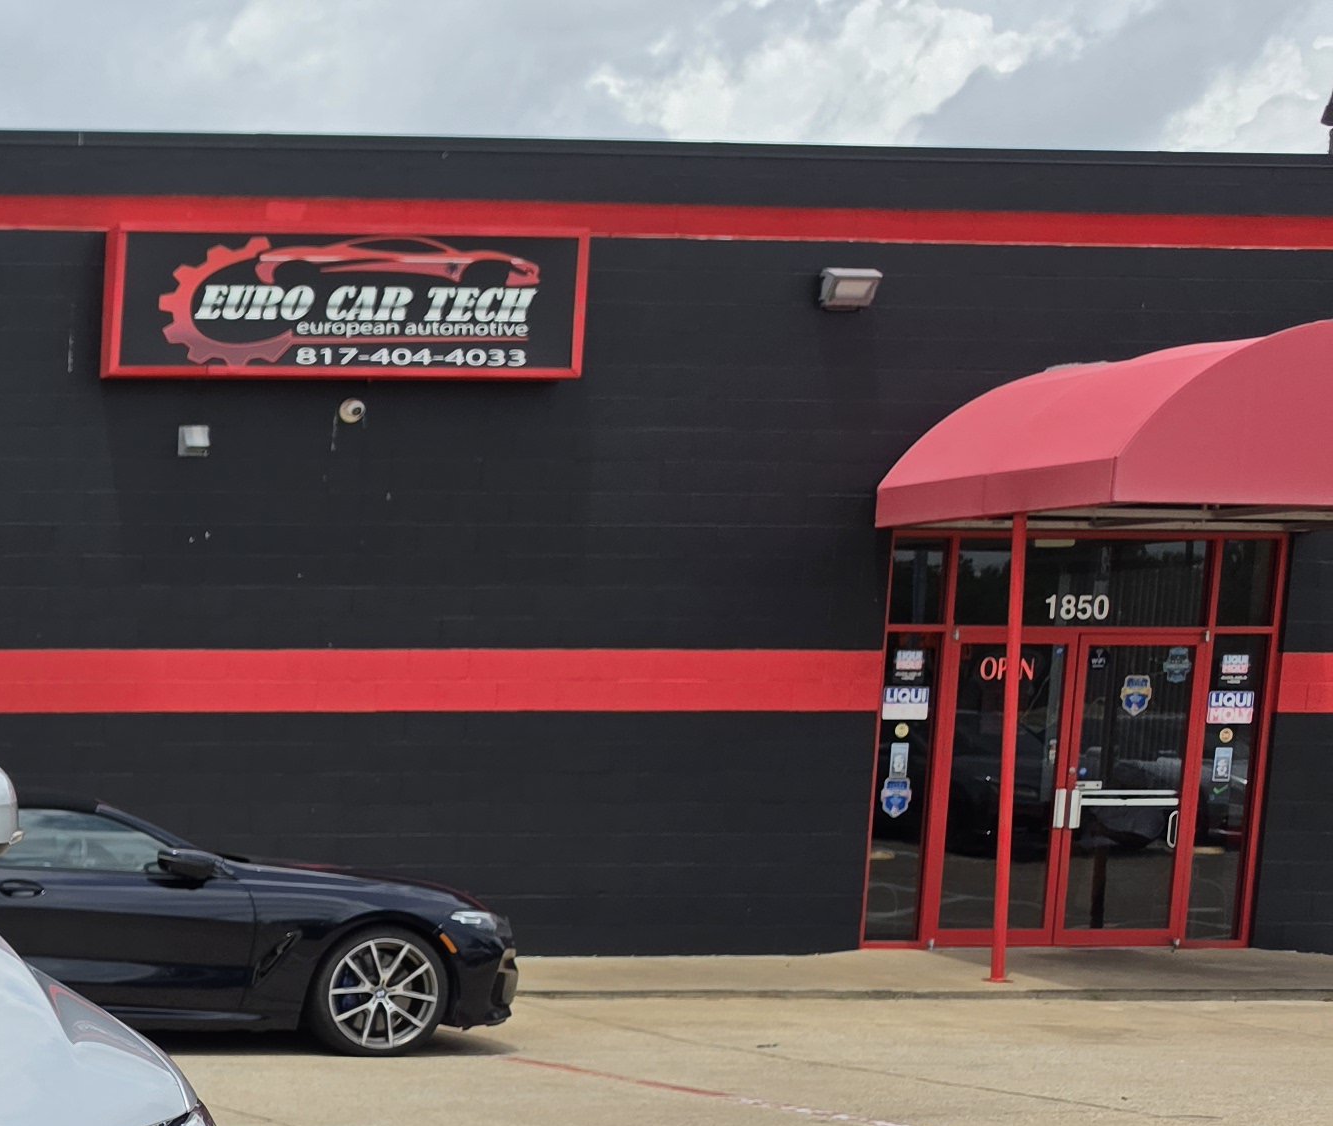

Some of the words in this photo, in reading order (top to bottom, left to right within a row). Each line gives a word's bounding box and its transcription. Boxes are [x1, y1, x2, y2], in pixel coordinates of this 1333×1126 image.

[194, 284, 316, 321] EURO
[325, 285, 414, 321] CAR
[424, 286, 539, 322] TECH
[296, 320, 400, 338] european
[405, 320, 529, 337] automotive
[295, 347, 527, 367] 817-404-4033
[1045, 594, 1110, 620] 1850
[980, 656, 1035, 680] OPN
[886, 687, 928, 703] LIQUI
[1211, 692, 1252, 707] LIQUI
